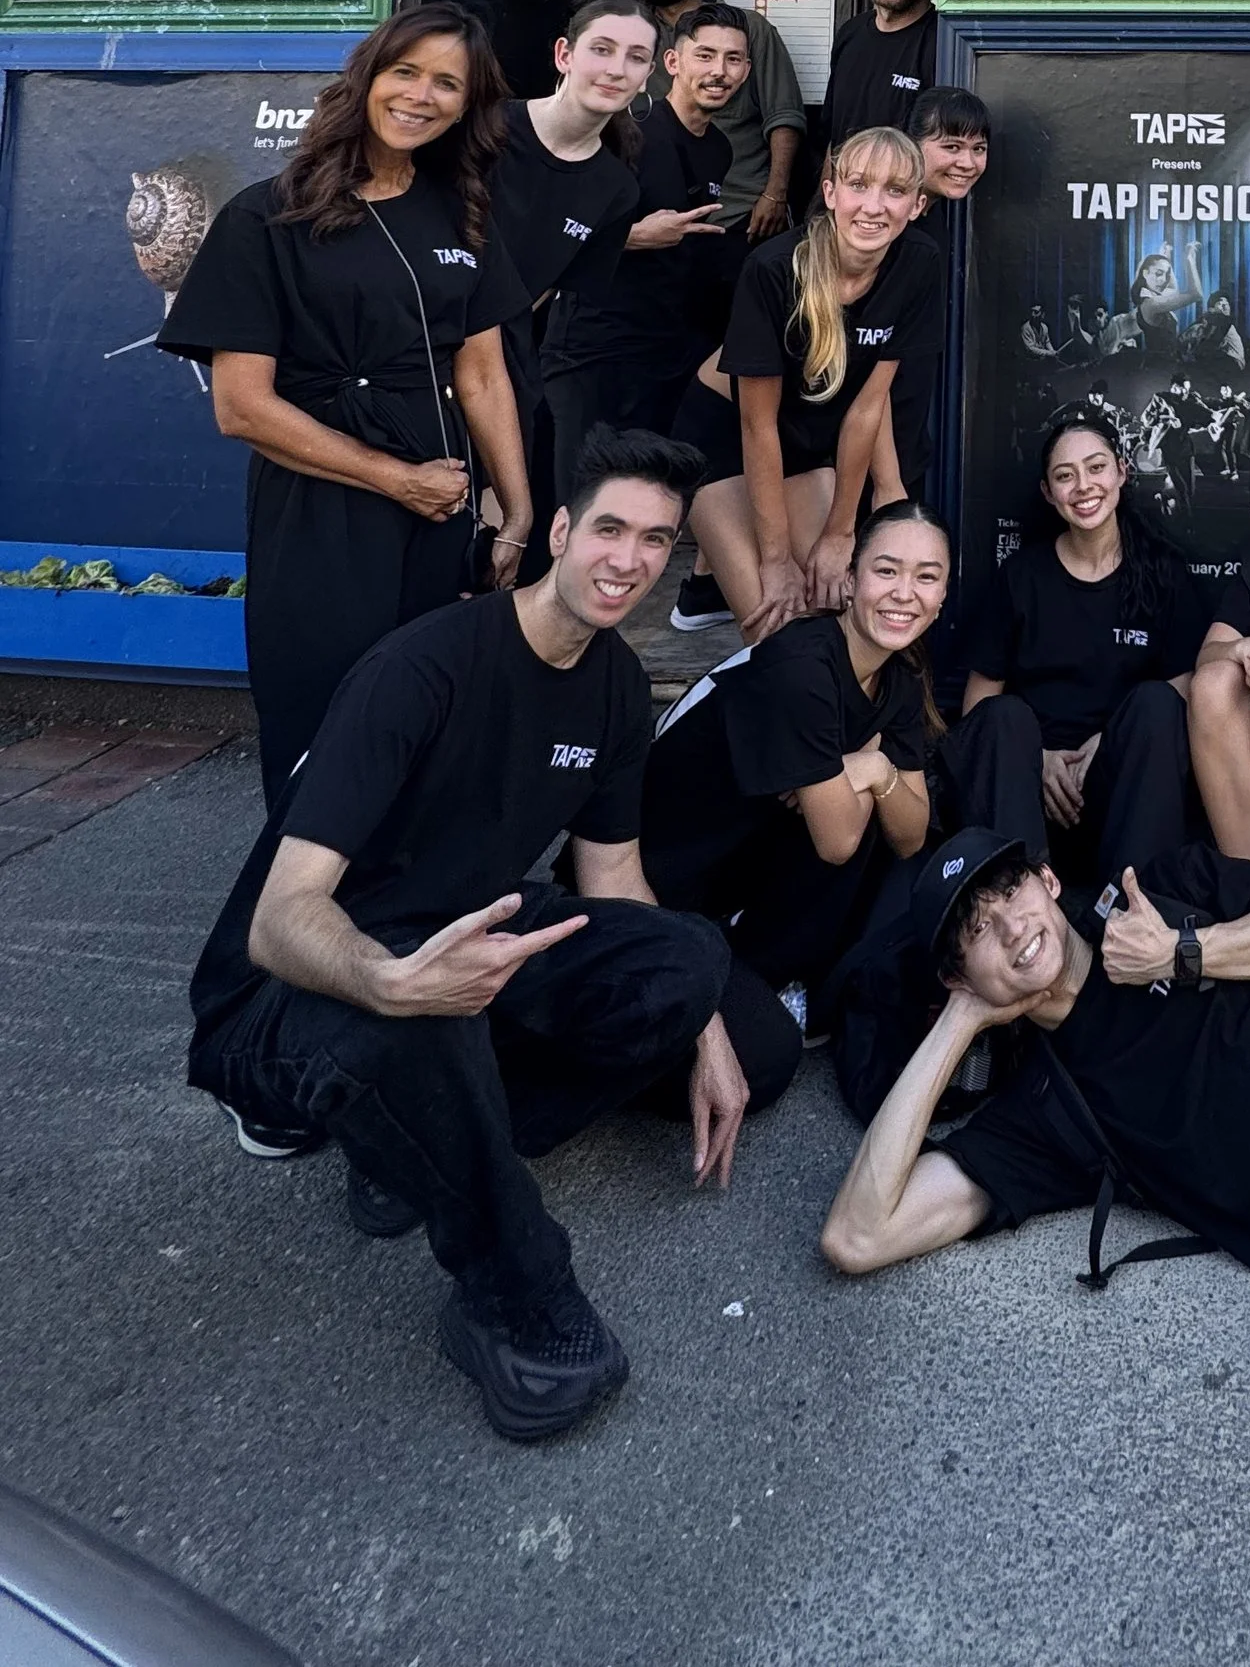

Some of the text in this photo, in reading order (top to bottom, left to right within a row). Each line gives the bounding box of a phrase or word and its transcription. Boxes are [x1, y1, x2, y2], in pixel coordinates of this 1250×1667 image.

[255, 100, 315, 129] bnz
[276, 136, 298, 150] find
[1152, 158, 1202, 170] Presents
[1067, 183, 1139, 220] TAP
